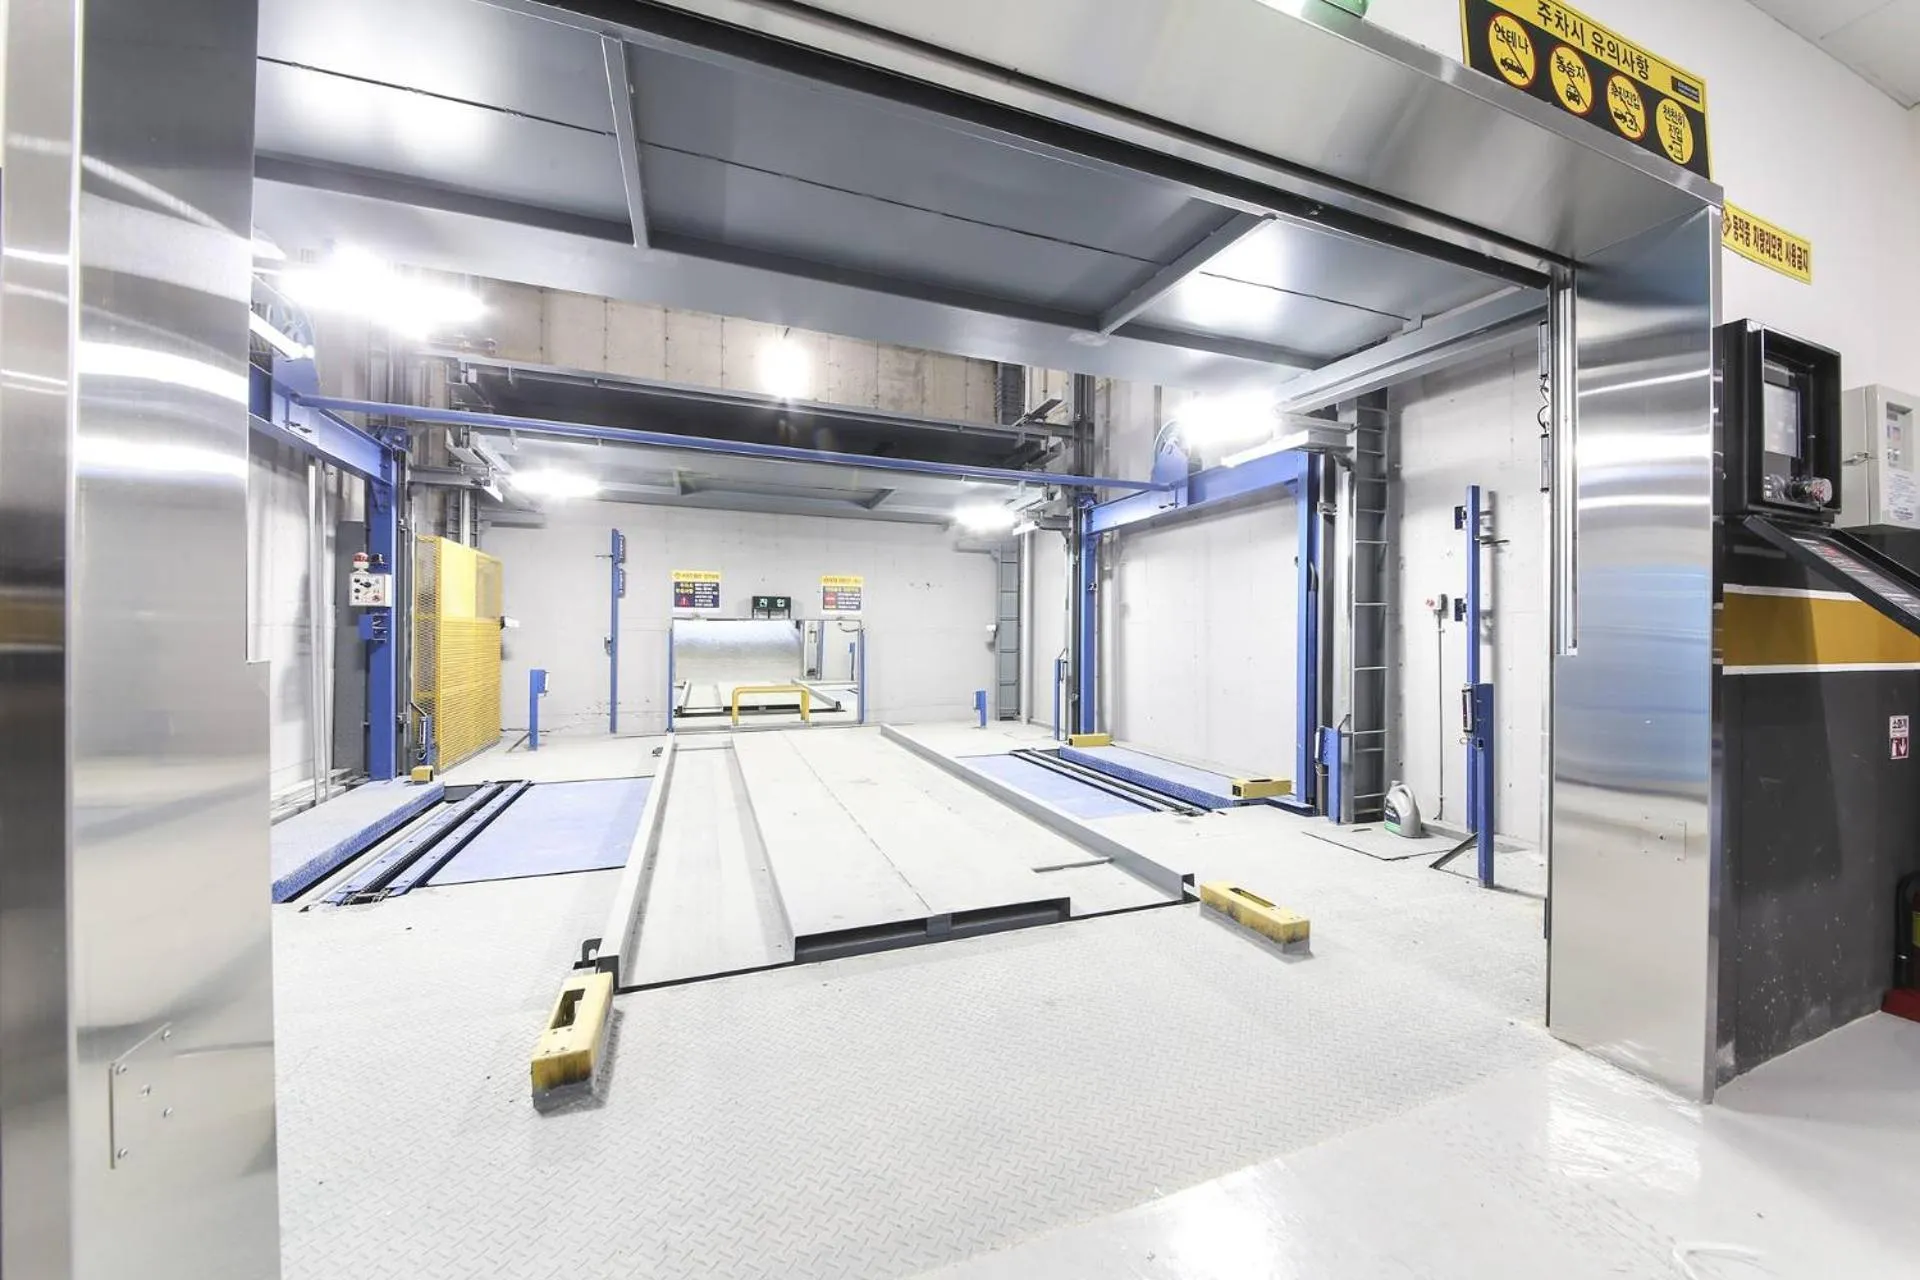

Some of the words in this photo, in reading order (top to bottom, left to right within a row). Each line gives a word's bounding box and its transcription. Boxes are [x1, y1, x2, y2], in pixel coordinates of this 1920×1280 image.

[1494, 22, 1528, 54] 안테나
[1537, 0, 1584, 46] 주차시
[1591, 31, 1649, 80] 유의사항
